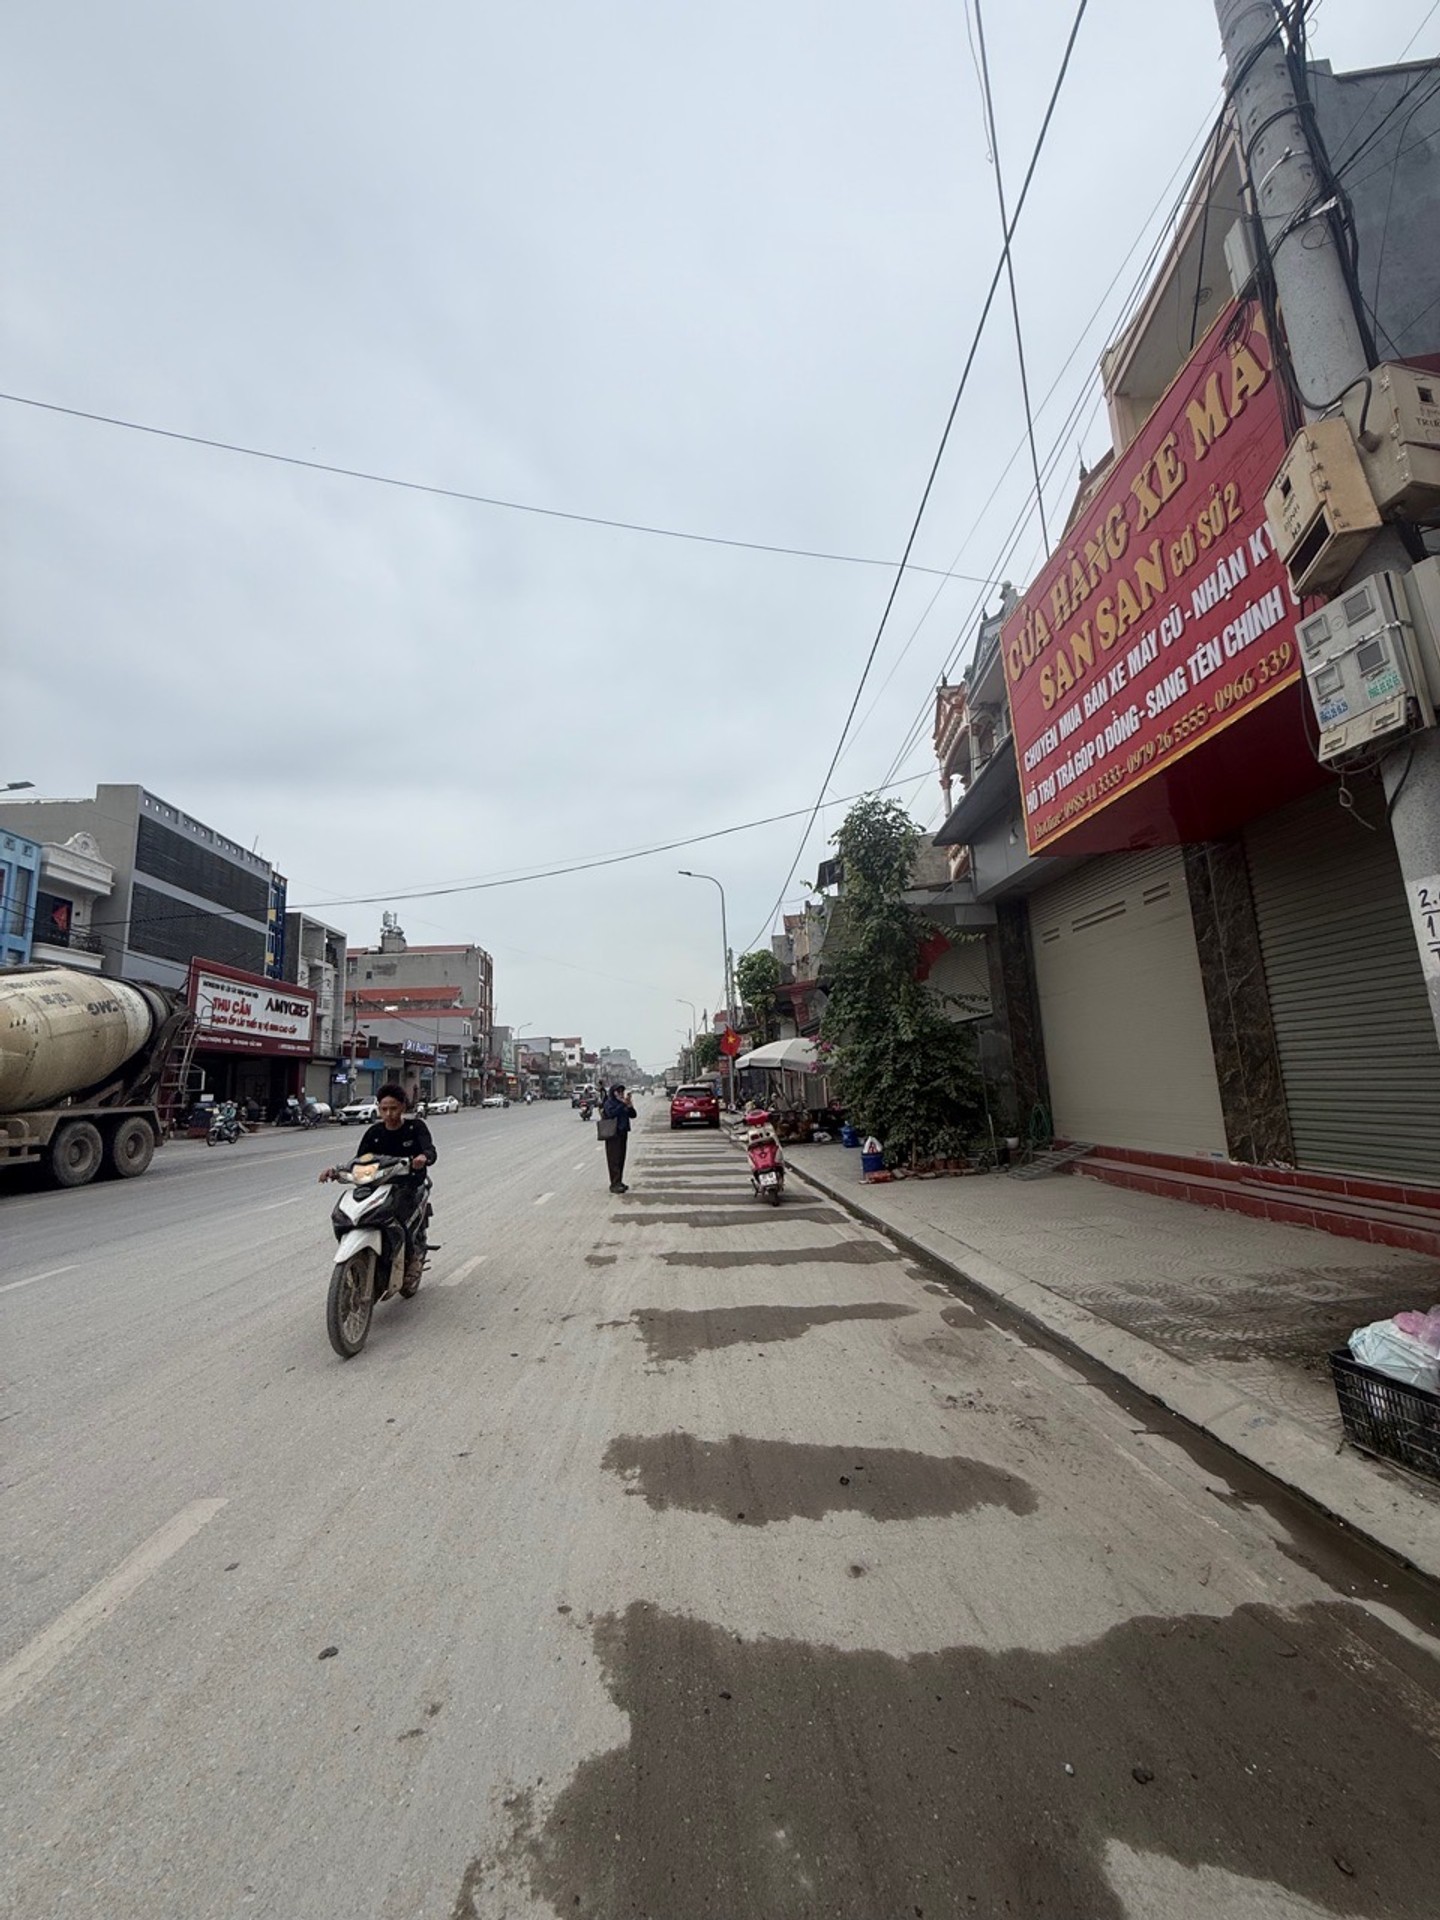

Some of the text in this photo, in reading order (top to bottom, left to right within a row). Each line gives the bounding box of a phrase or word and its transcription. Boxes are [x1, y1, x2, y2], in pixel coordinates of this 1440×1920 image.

[1008, 604, 1052, 681] CỬA
[1052, 502, 1130, 632] HÀNG
[1131, 432, 1186, 533] XE
[1039, 482, 1243, 710] SAN SAN CƠ SỞ 2
[1060, 702, 1083, 742] MUA
[1083, 680, 1109, 719] BÁN
[1109, 660, 1127, 697] XE
[1127, 630, 1159, 680] MÁY
[1160, 602, 1184, 647] CŨ
[1191, 546, 1249, 621] NHẬN
[1037, 771, 1056, 802] TRỢ
[1056, 749, 1079, 790] TRẢ
[1074, 739, 1095, 779] GÓP
[1146, 666, 1190, 719] SANG
[1188, 642, 1224, 685] TÊN
[1222, 584, 1286, 658] CHÍNH
[1214, 668, 1256, 714] 0966
[1258, 641, 1293, 686] 339
